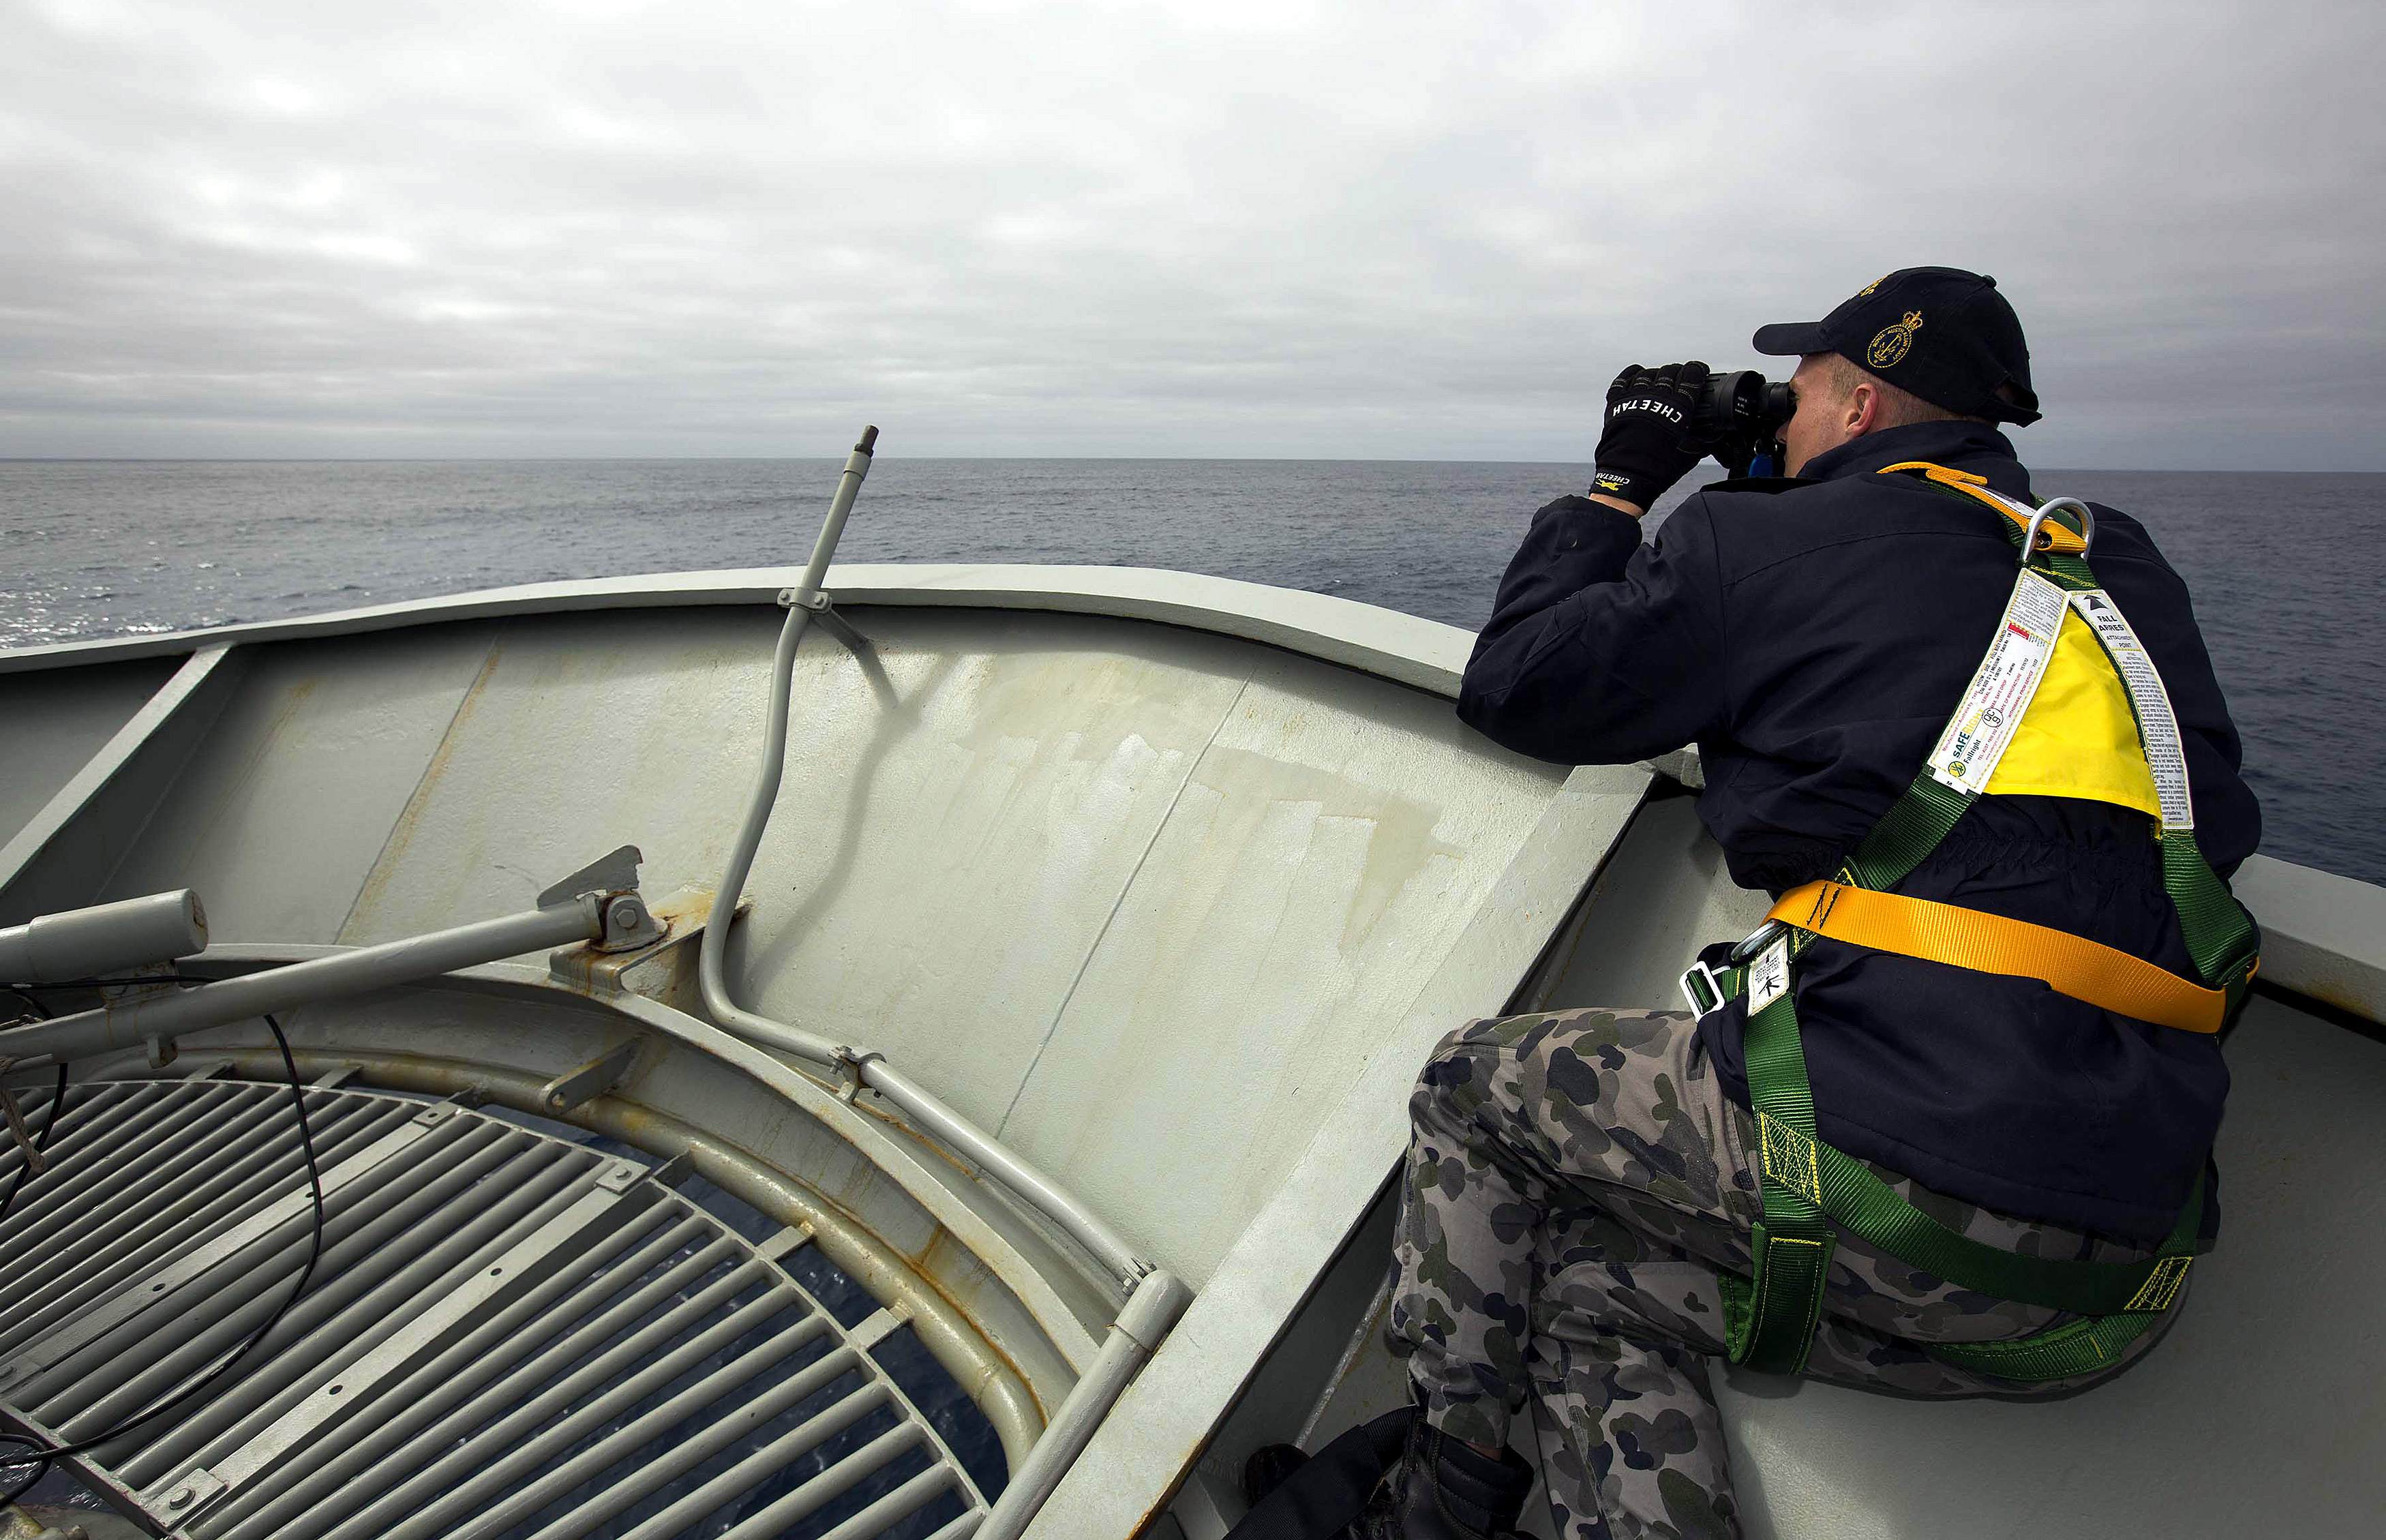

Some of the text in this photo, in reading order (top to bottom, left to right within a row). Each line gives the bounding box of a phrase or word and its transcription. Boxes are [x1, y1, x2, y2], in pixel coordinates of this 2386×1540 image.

[1873, 333, 1886, 347] ROYAL
[1892, 346, 1905, 361] NAVY
[1612, 399, 1683, 423] CHEETAH
[1595, 472, 1630, 485] CHEETAH
[2006, 672, 2022, 698] MANUFACTURE
[1983, 709, 1995, 721] QC
[1992, 715, 2001, 723] 9
[1963, 738, 1981, 764] Fallright
